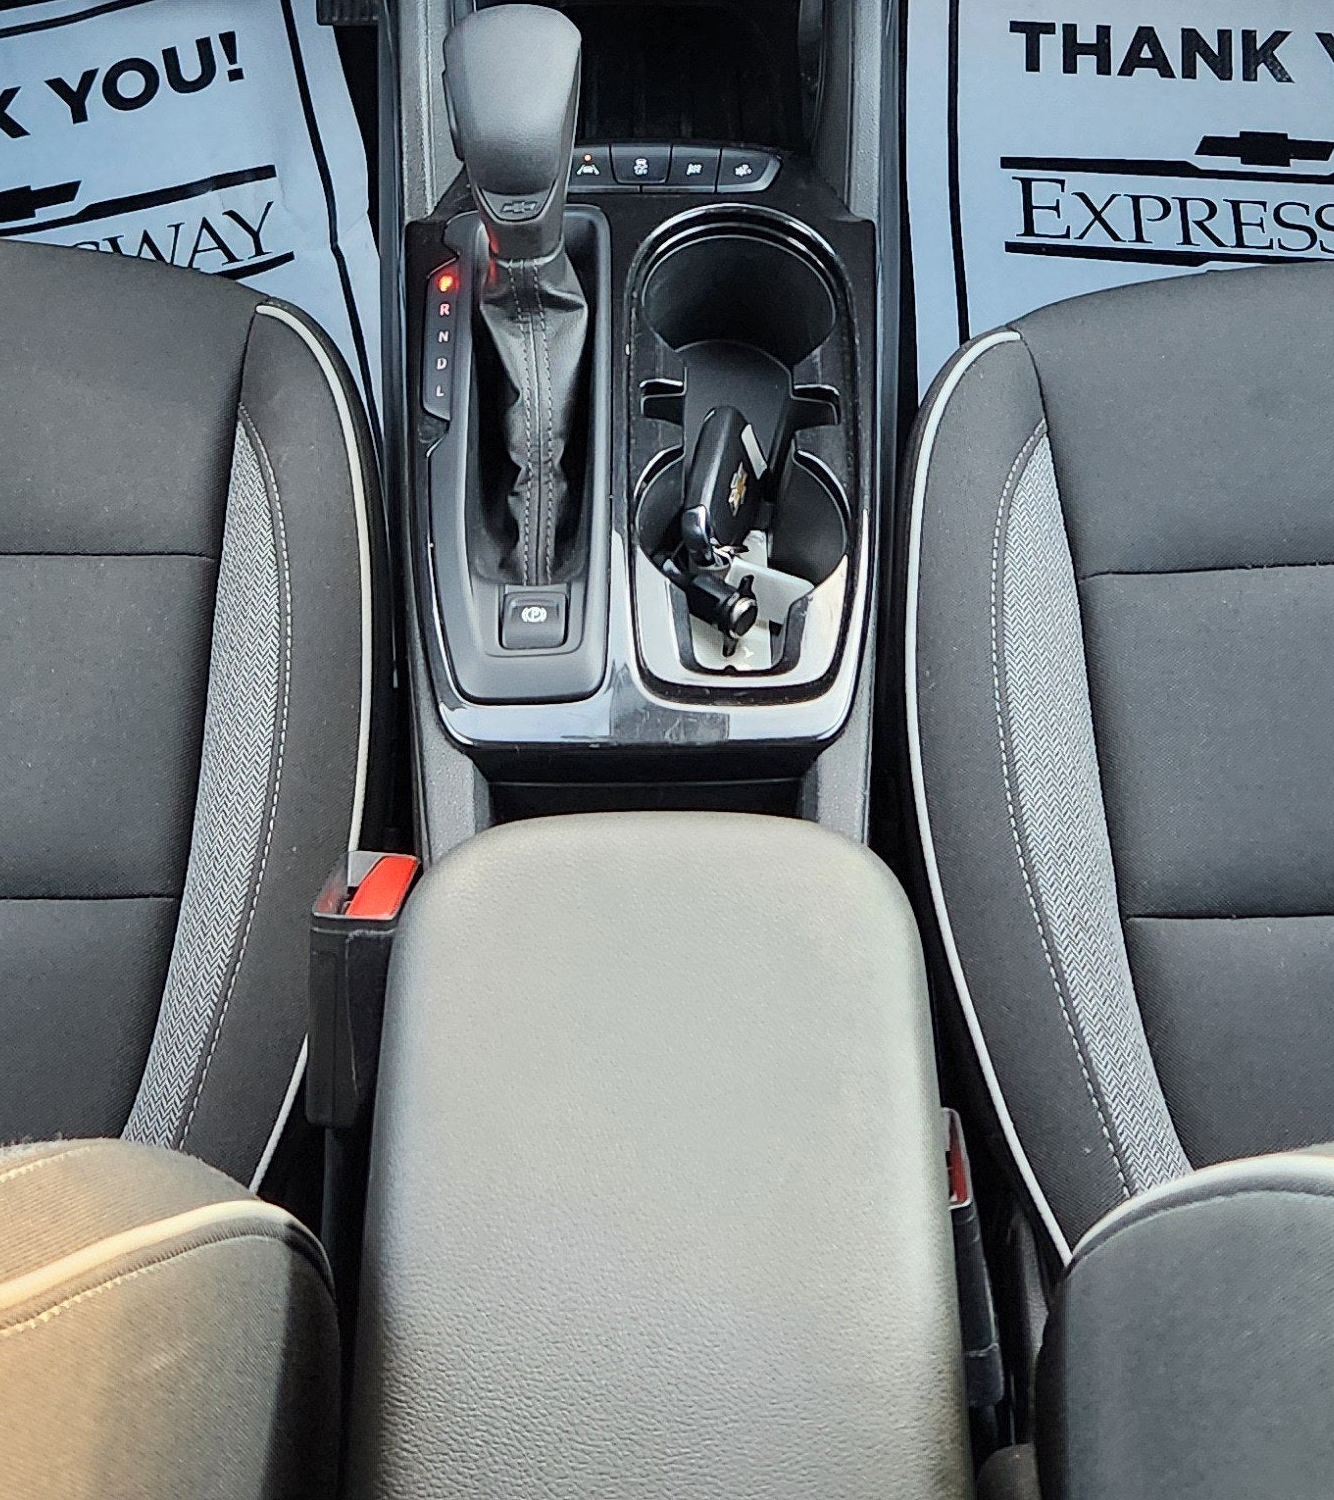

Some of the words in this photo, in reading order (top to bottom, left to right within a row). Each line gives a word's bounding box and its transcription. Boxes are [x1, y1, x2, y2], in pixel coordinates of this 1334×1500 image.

[1009, 20, 1295, 84] THANK
[44, 31, 244, 125] YOU!
[439, 303, 450, 316] R
[438, 331, 449, 343] N
[436, 358, 447, 370] D
[436, 385, 445, 397] L
